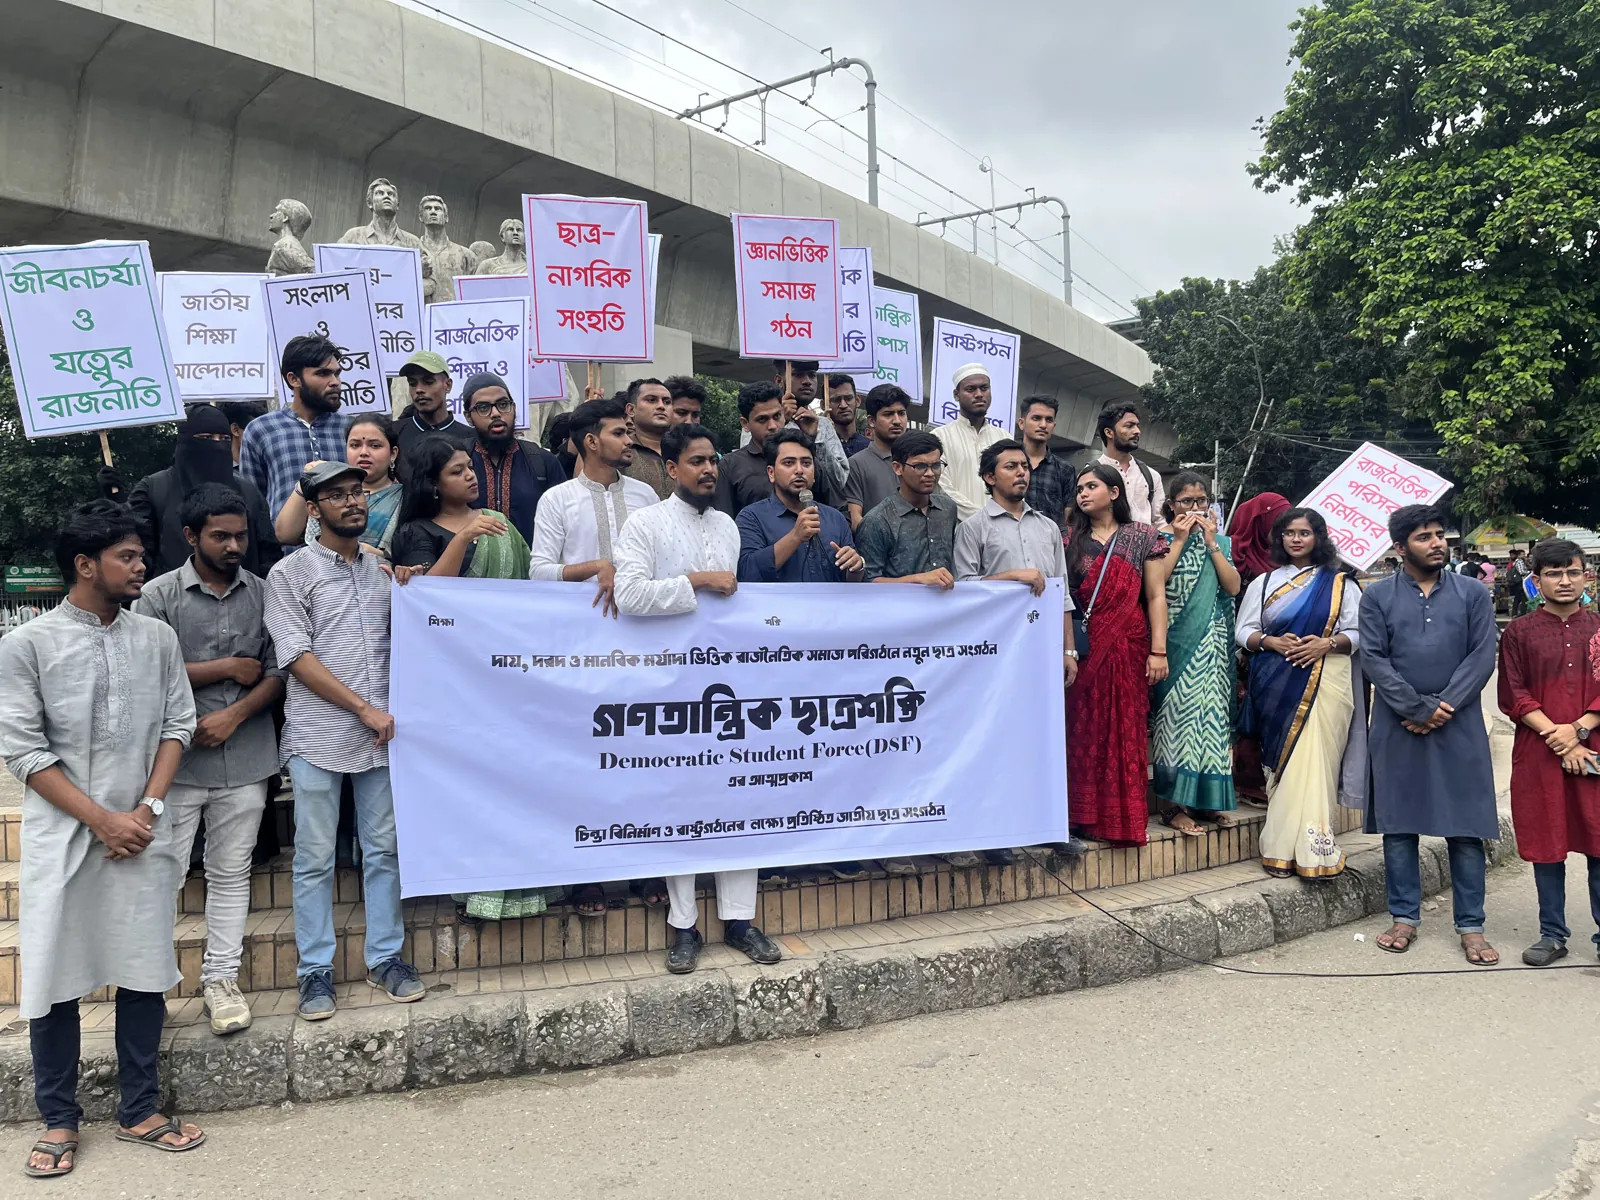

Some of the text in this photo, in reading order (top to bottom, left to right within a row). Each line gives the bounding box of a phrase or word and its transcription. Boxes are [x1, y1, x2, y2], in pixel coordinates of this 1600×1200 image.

[745, 236, 830, 263] জ্ঞানভিত্তিক
[5, 258, 141, 295] জীবনচর্যা
[545, 258, 632, 289] নাগরিক
[181, 288, 250, 312] জাতীয়
[283, 282, 350, 307] সংলাপ
[760, 281, 816, 302] সমাজ
[72, 309, 95, 331] ও
[434, 317, 520, 346] রাজনৈতিক
[556, 302, 626, 334] সংহতি
[769, 313, 813, 339] গঠন
[185, 323, 237, 345] শিক্ষা
[942, 332, 1011, 360] রাষ্ট্রগঠন
[50, 347, 133, 382] যত্নের
[493, 360, 509, 377] ও
[872, 360, 898, 382] ঠন
[37, 377, 161, 419] রাজনীতি
[1357, 457, 1432, 500] রাজনৈতিক
[1319, 493, 1389, 539] নির্মাণের
[428, 614, 455, 627] শিক্ষা
[532, 654, 566, 668] দরদ
[569, 655, 581, 668] ও
[583, 648, 641, 668] মানবিক
[643, 648, 688, 667] মর্যাদা
[689, 646, 734, 667] ভিত্তিক
[736, 645, 804, 664] রাজনৈতিক
[807, 648, 845, 662] সমাজ
[847, 643, 900, 660] পরিগঠনে
[902, 645, 930, 665] নতুন
[931, 644, 956, 659] ছাত্র
[956, 640, 998, 658] সংগঠন
[593, 676, 926, 741] গণতান্ত্রিক ছাত্রশক্তি
[599, 735, 922, 770] Democratic Student Force(DSF)
[727, 771, 813, 788] এর আত্মপ্রকাশ
[575, 824, 607, 843] চিন্তা
[609, 822, 661, 840] বিনির্মাণ
[663, 826, 674, 837] ও
[676, 818, 745, 839] রাষ্ট্রগঠনের
[786, 808, 834, 830] প্রতিষ্ঠিত
[836, 805, 876, 823] জাতীয়
[877, 807, 901, 822] ছাত্র
[901, 802, 945, 819] সংগঠন
